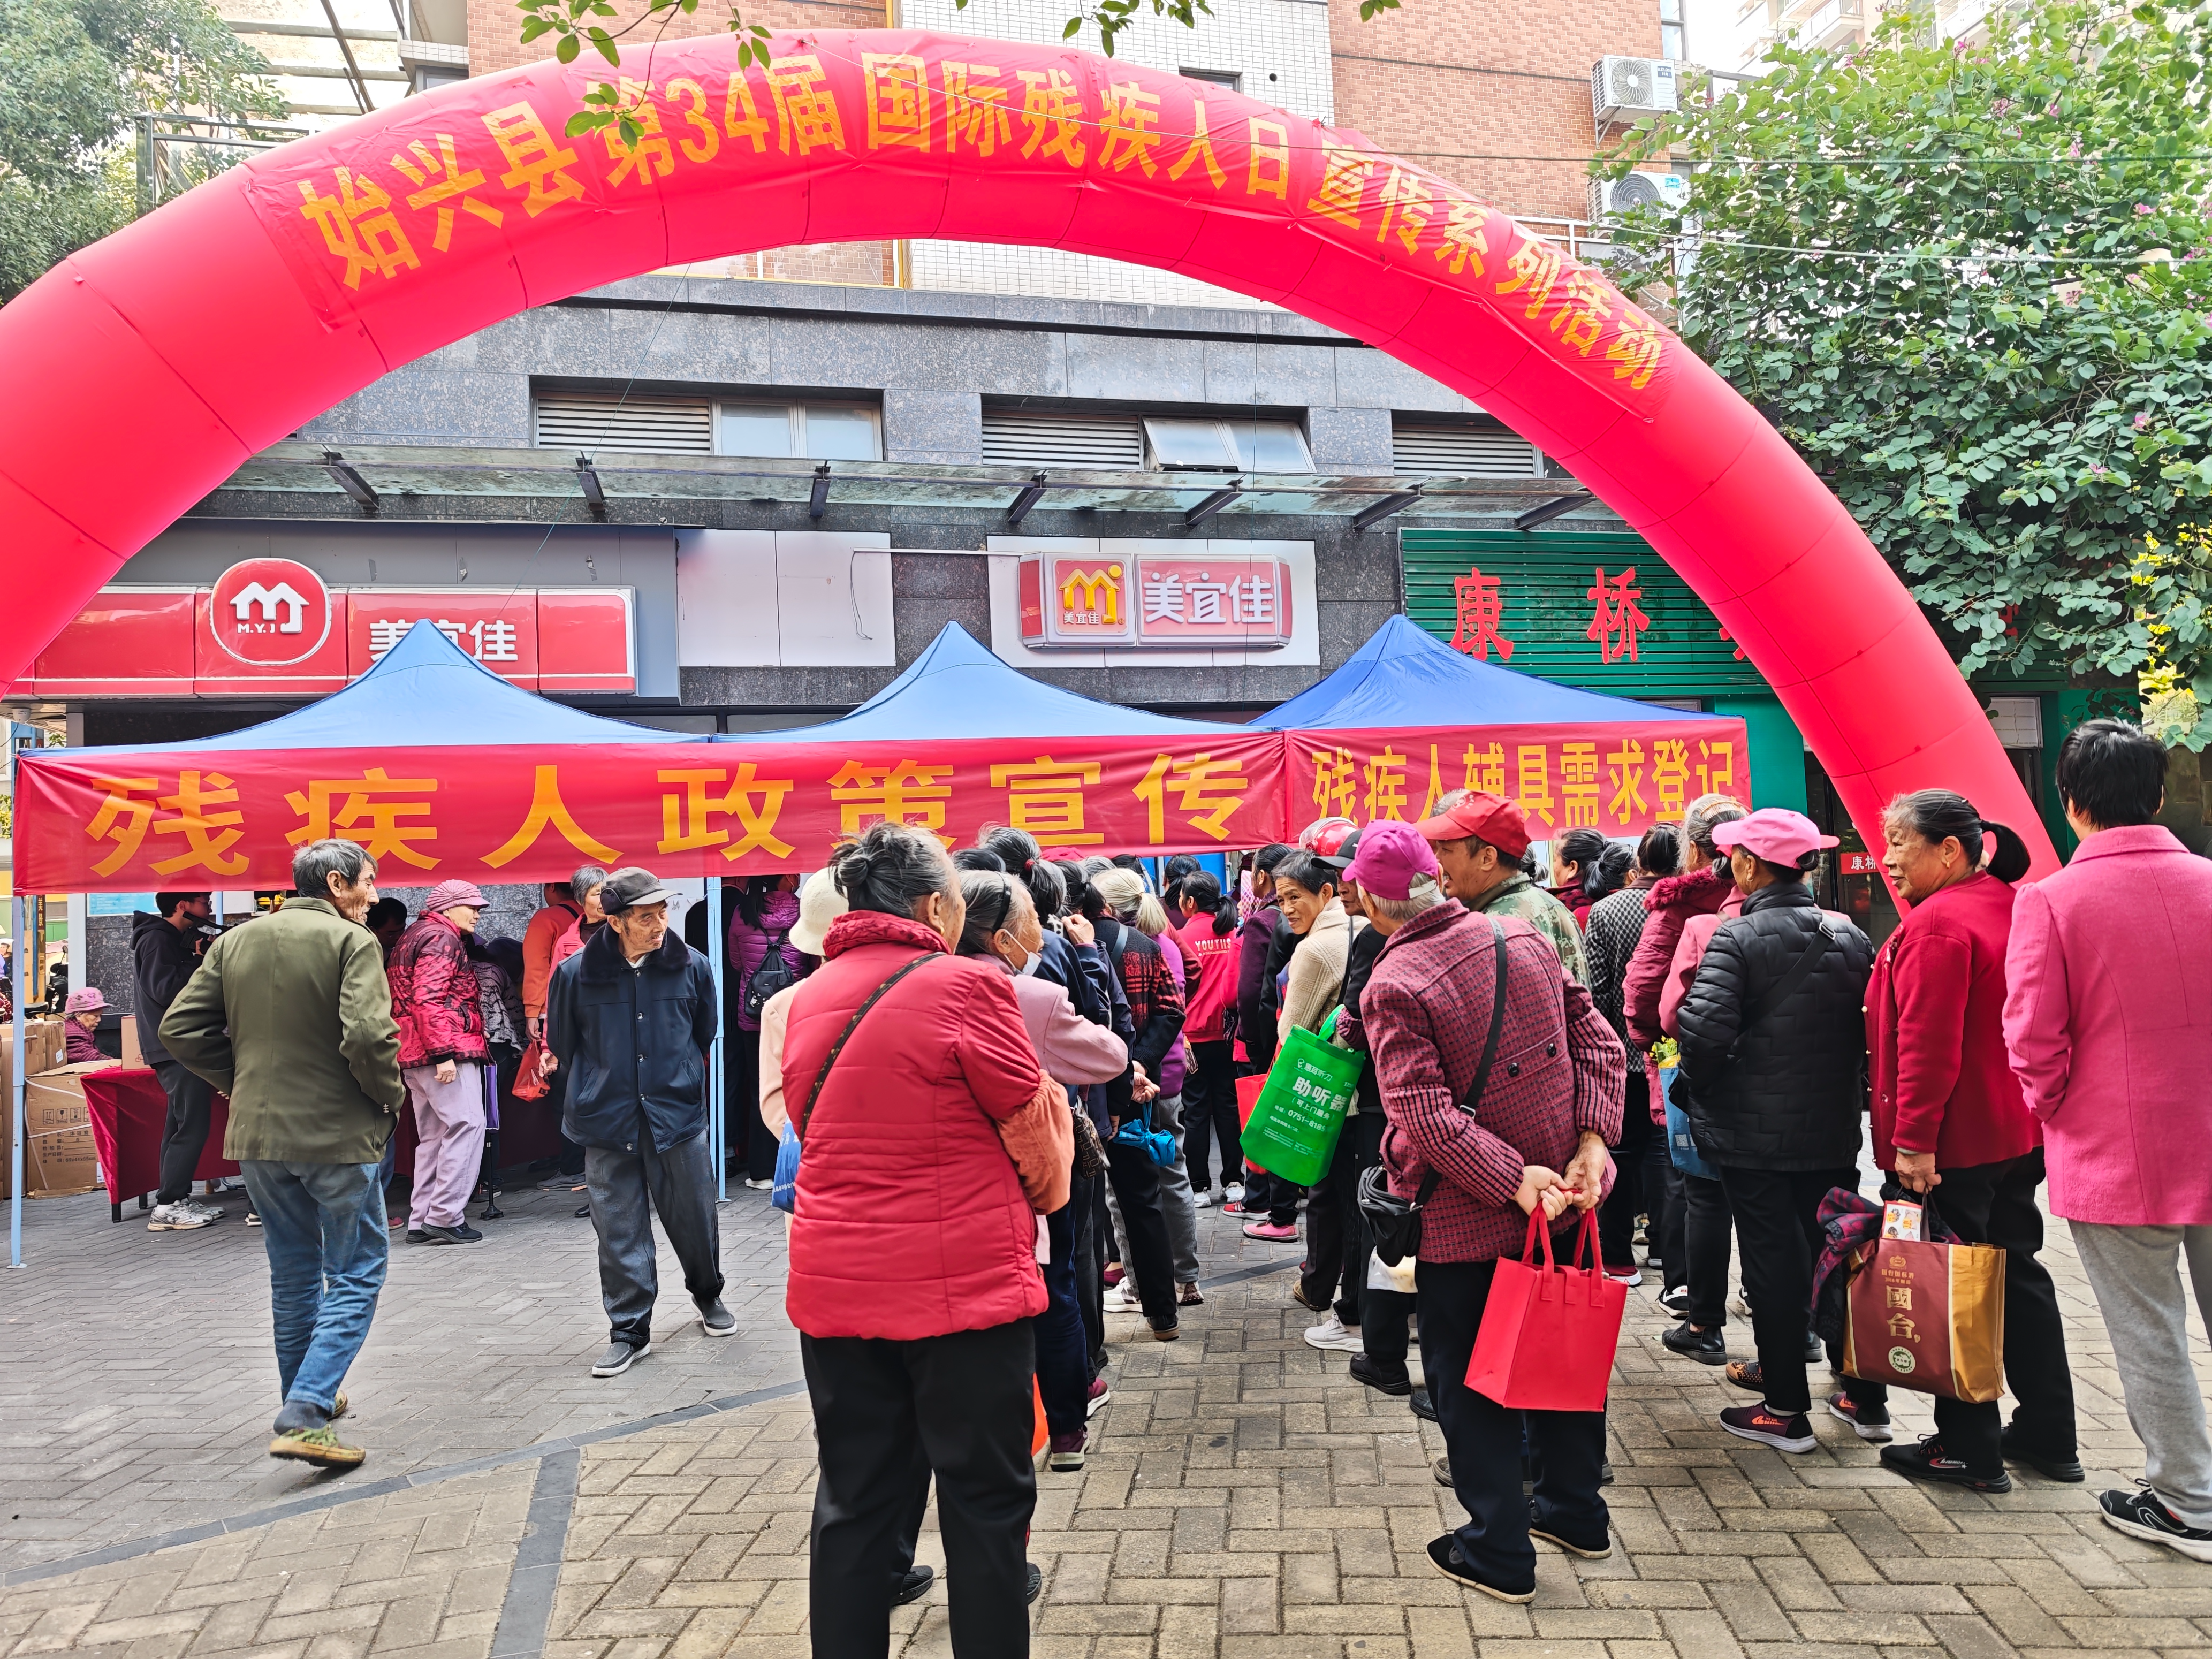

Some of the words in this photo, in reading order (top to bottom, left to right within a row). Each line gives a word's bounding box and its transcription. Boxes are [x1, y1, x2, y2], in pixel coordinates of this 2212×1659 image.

[299, 52, 1662, 390] 始兴县第34届国际残疾人日宣传系列活动
[237, 623, 276, 634] M.Y.J
[1063, 611, 1099, 625] 美宜佳
[1143, 572, 1274, 623] 美宜佳
[1450, 567, 1745, 664] 康桥
[85, 752, 1248, 877] 残疾人政策宣传
[1312, 739, 1735, 827] 残疾人辅具需求登记
[1292, 1076, 1347, 1112] 助听器
